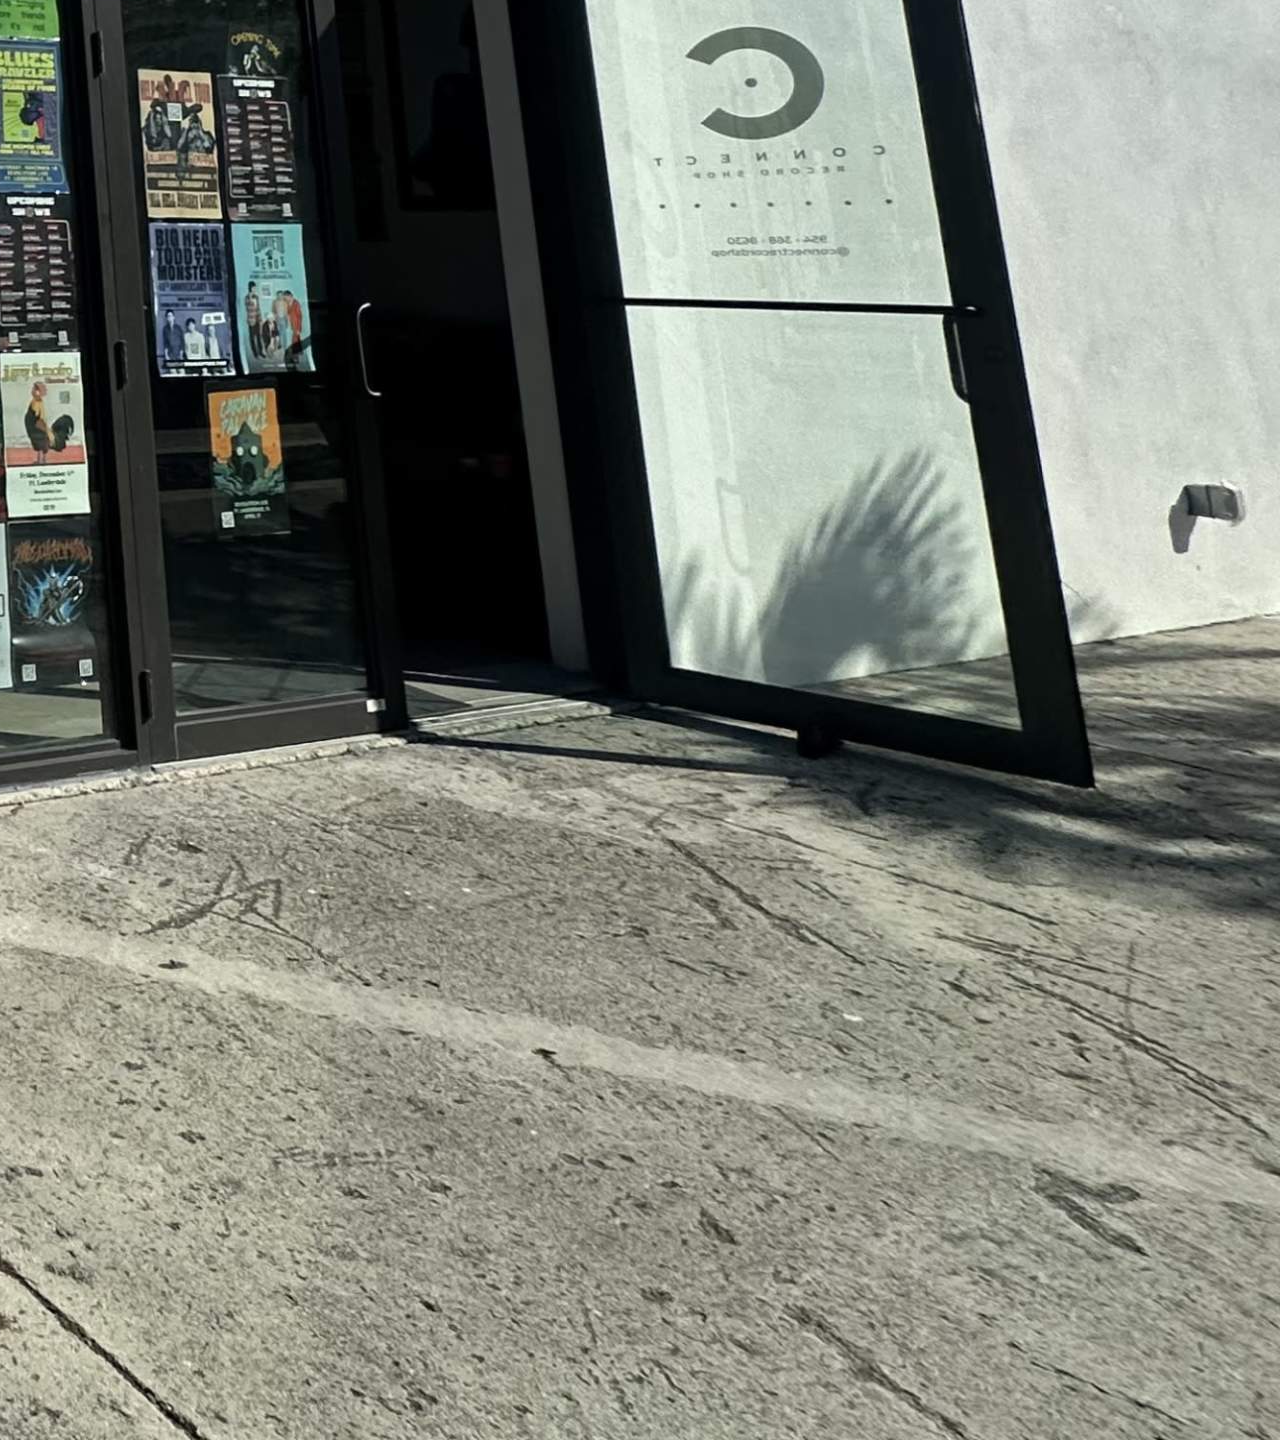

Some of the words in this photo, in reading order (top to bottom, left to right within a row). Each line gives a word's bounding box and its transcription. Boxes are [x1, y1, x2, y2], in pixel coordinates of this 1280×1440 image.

[155, 228, 179, 248] BIG
[183, 228, 220, 249] HEAD
[156, 248, 193, 265] TODD
[157, 265, 223, 281] MONSTERS
